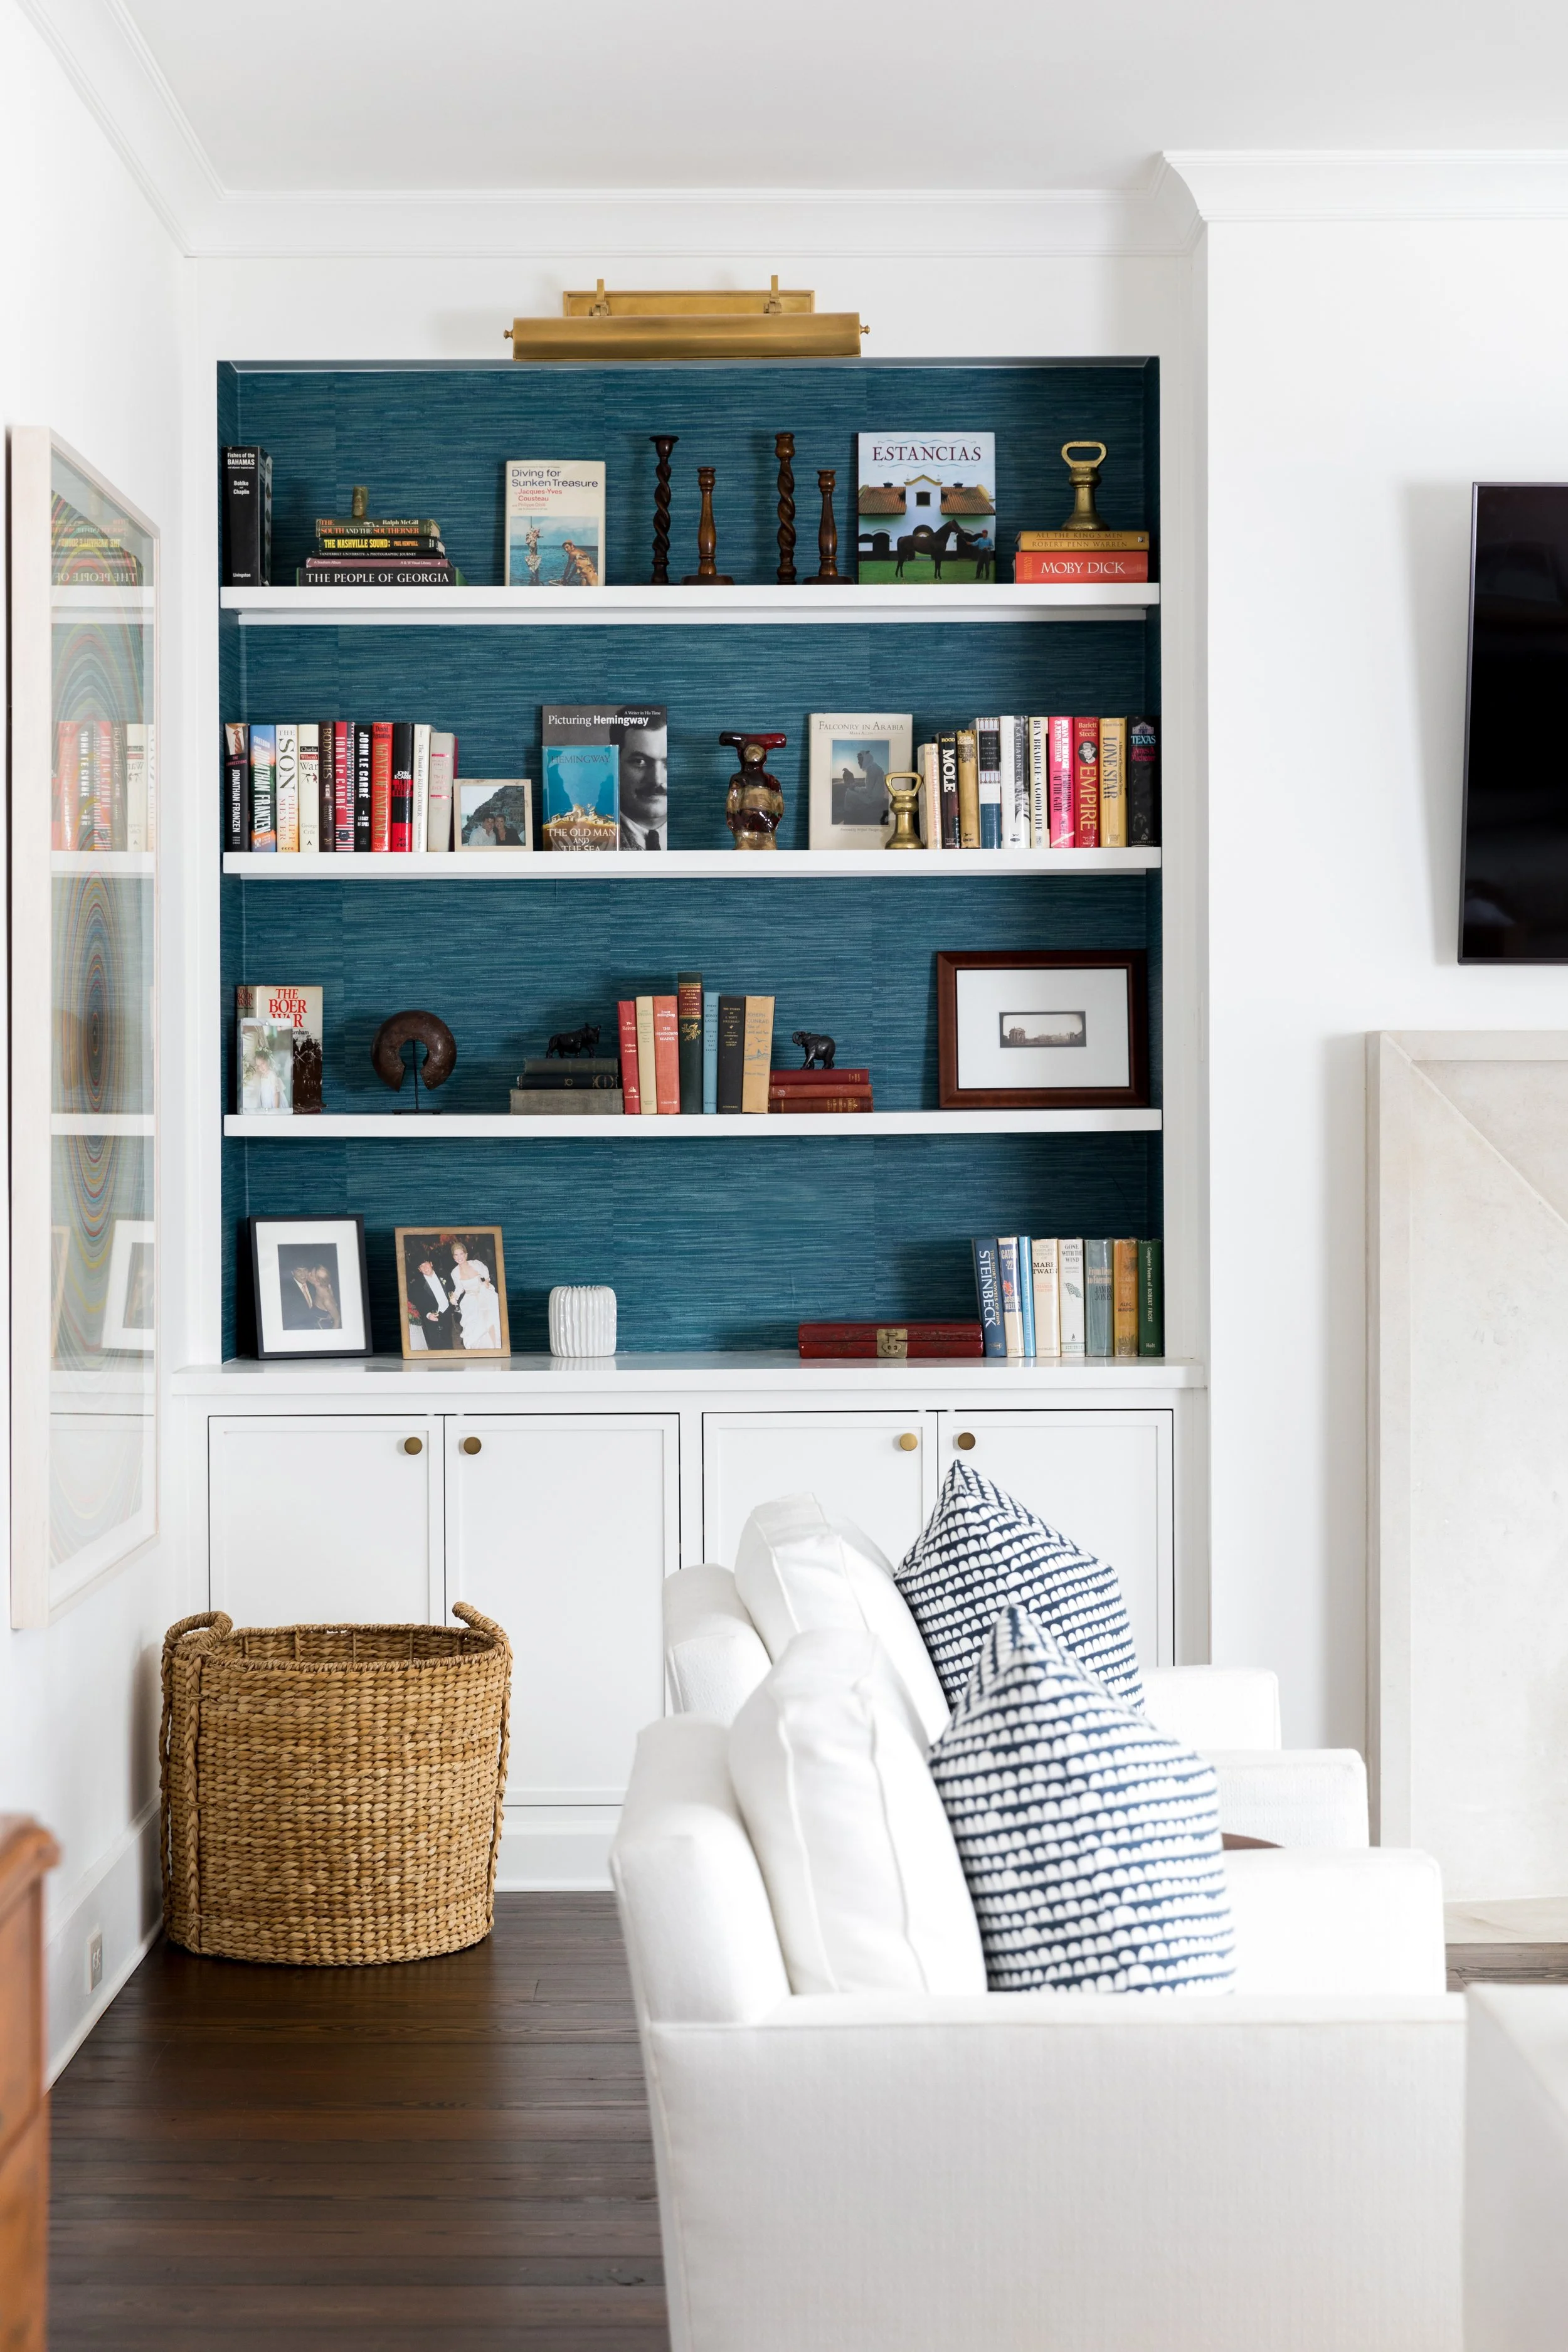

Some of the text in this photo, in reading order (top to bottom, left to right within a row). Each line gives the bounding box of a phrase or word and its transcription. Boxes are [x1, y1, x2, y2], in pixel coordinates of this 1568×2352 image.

[872, 447, 981, 461] ESTANCIAS
[512, 469, 544, 478] Diving
[512, 479, 598, 487] Sunken Treasure
[324, 539, 336, 548] THE
[337, 539, 368, 548] NASHVILLE
[369, 539, 391, 548] SOUND:
[1041, 561, 1126, 574] MOBY DICK
[306, 573, 449, 583] THE PEOPLE OF GEORGIA
[548, 715, 649, 727] Picturing Hemingway
[323, 728, 332, 753] BODY
[1130, 735, 1156, 744] TEXAS
[278, 738, 295, 792] SON
[359, 732, 370, 798] JOHN LE CARRÉ
[375, 742, 388, 775] AGENTS
[551, 755, 611, 763] HEMINGWAY
[253, 744, 270, 792] JONATHAN
[300, 762, 319, 770] War
[323, 760, 332, 779] LIES
[943, 749, 956, 792] MOLE
[1103, 738, 1118, 800] LONE STAR
[232, 769, 241, 801] JONATHAN
[375, 776, 388, 788] OF
[1053, 783, 1062, 795] THE
[1054, 797, 1062, 812] GATE
[1080, 766, 1097, 831] EMPIRE
[232, 803, 241, 832] FRANZEN
[254, 795, 271, 835] FRANZEN
[547, 829, 616, 837] THE OLD MAN
[276, 988, 299, 999] THE
[268, 999, 307, 1013] BOER
[979, 1250, 996, 1328] STEINBECK
[995, 1303, 999, 1311] OF
